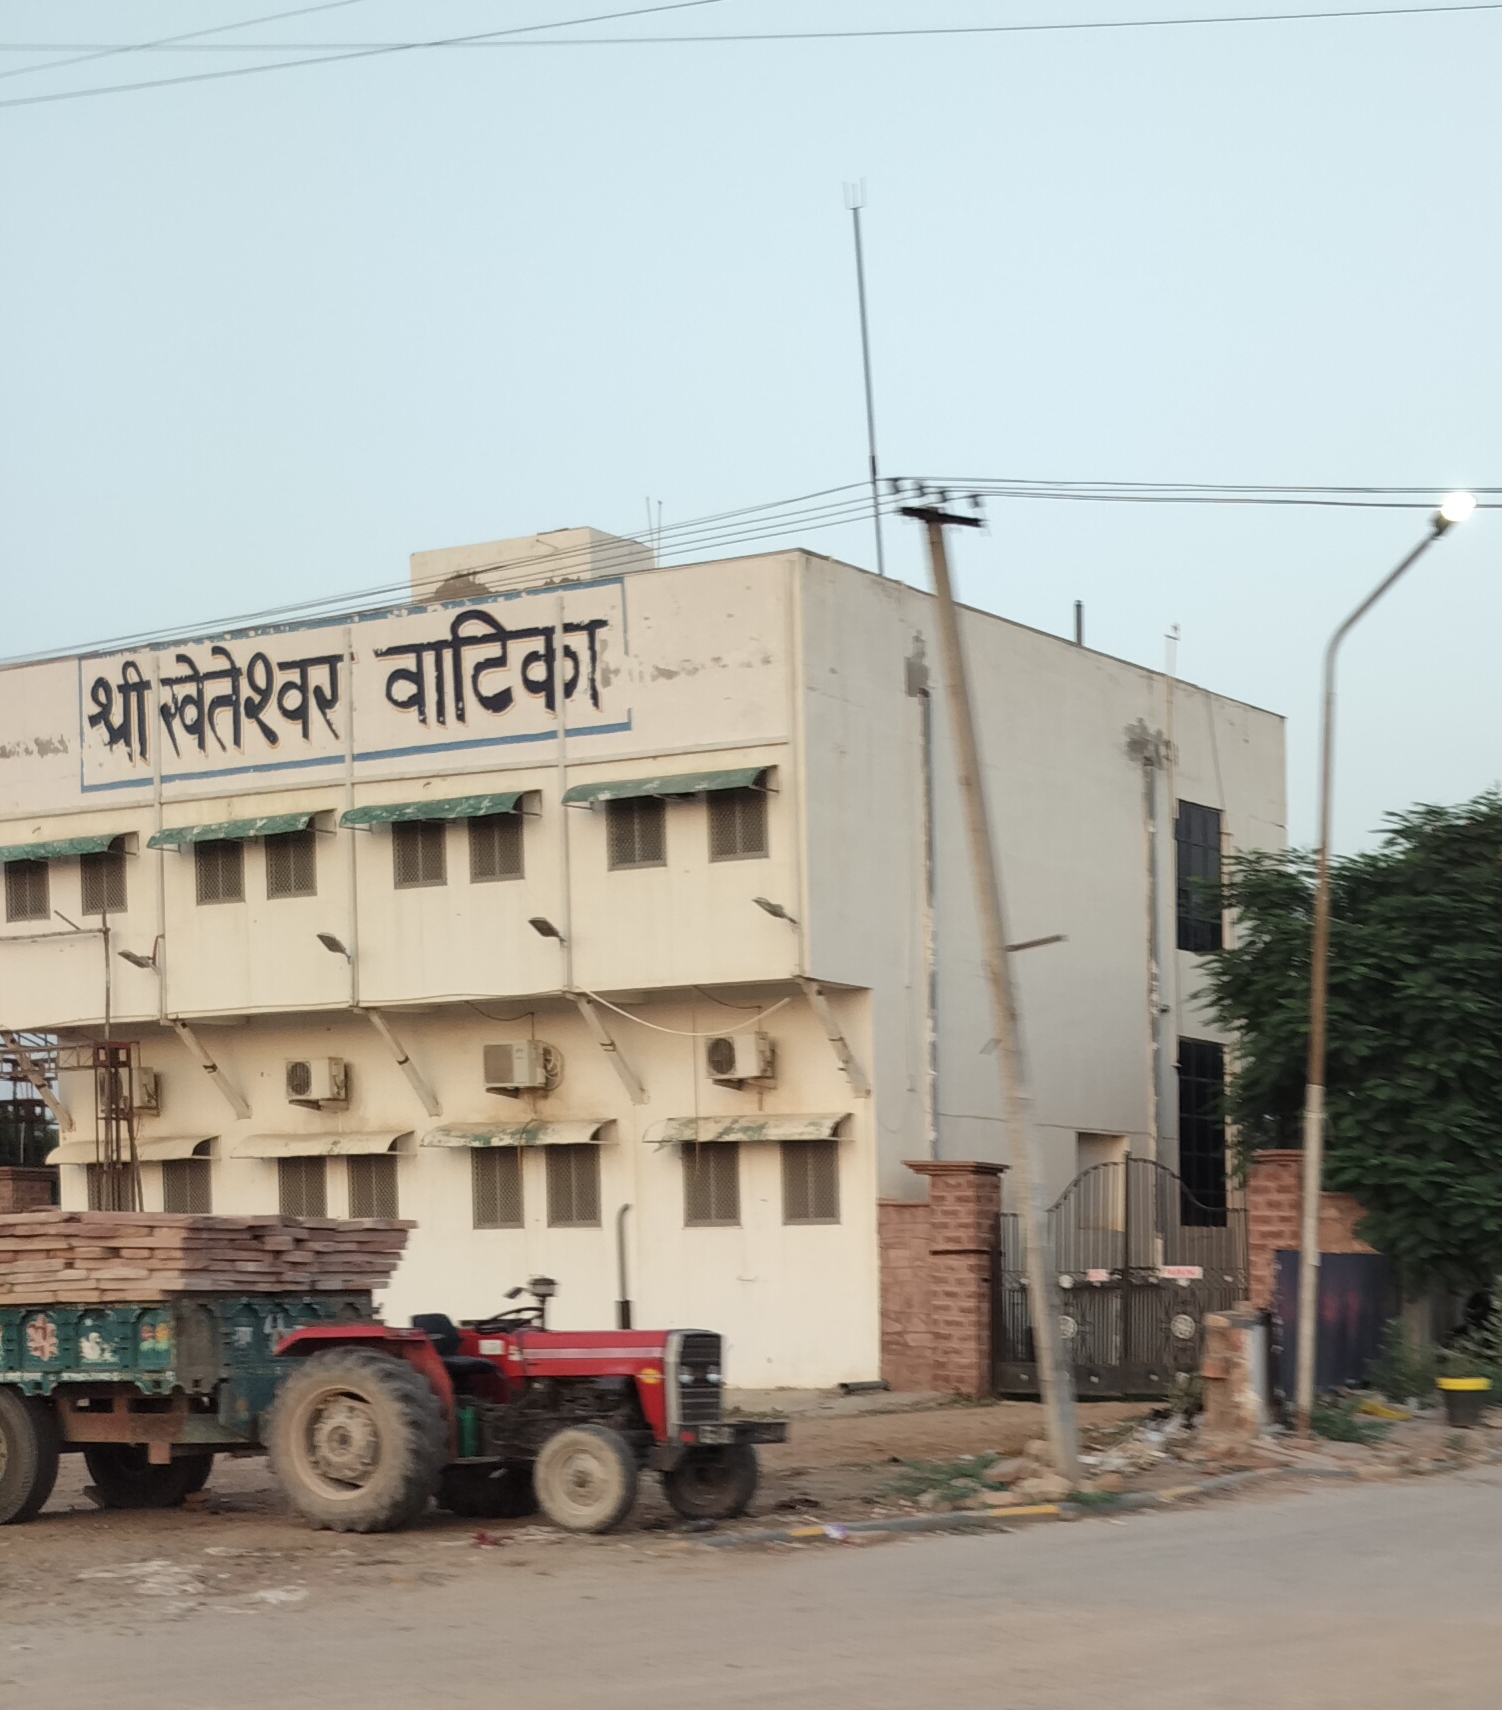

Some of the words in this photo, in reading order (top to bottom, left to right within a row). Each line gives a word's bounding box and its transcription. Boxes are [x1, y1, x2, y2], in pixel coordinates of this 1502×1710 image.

[88, 660, 152, 763] श्री
[160, 646, 355, 758] खेतेश्वर
[373, 609, 609, 725] वाटिका
